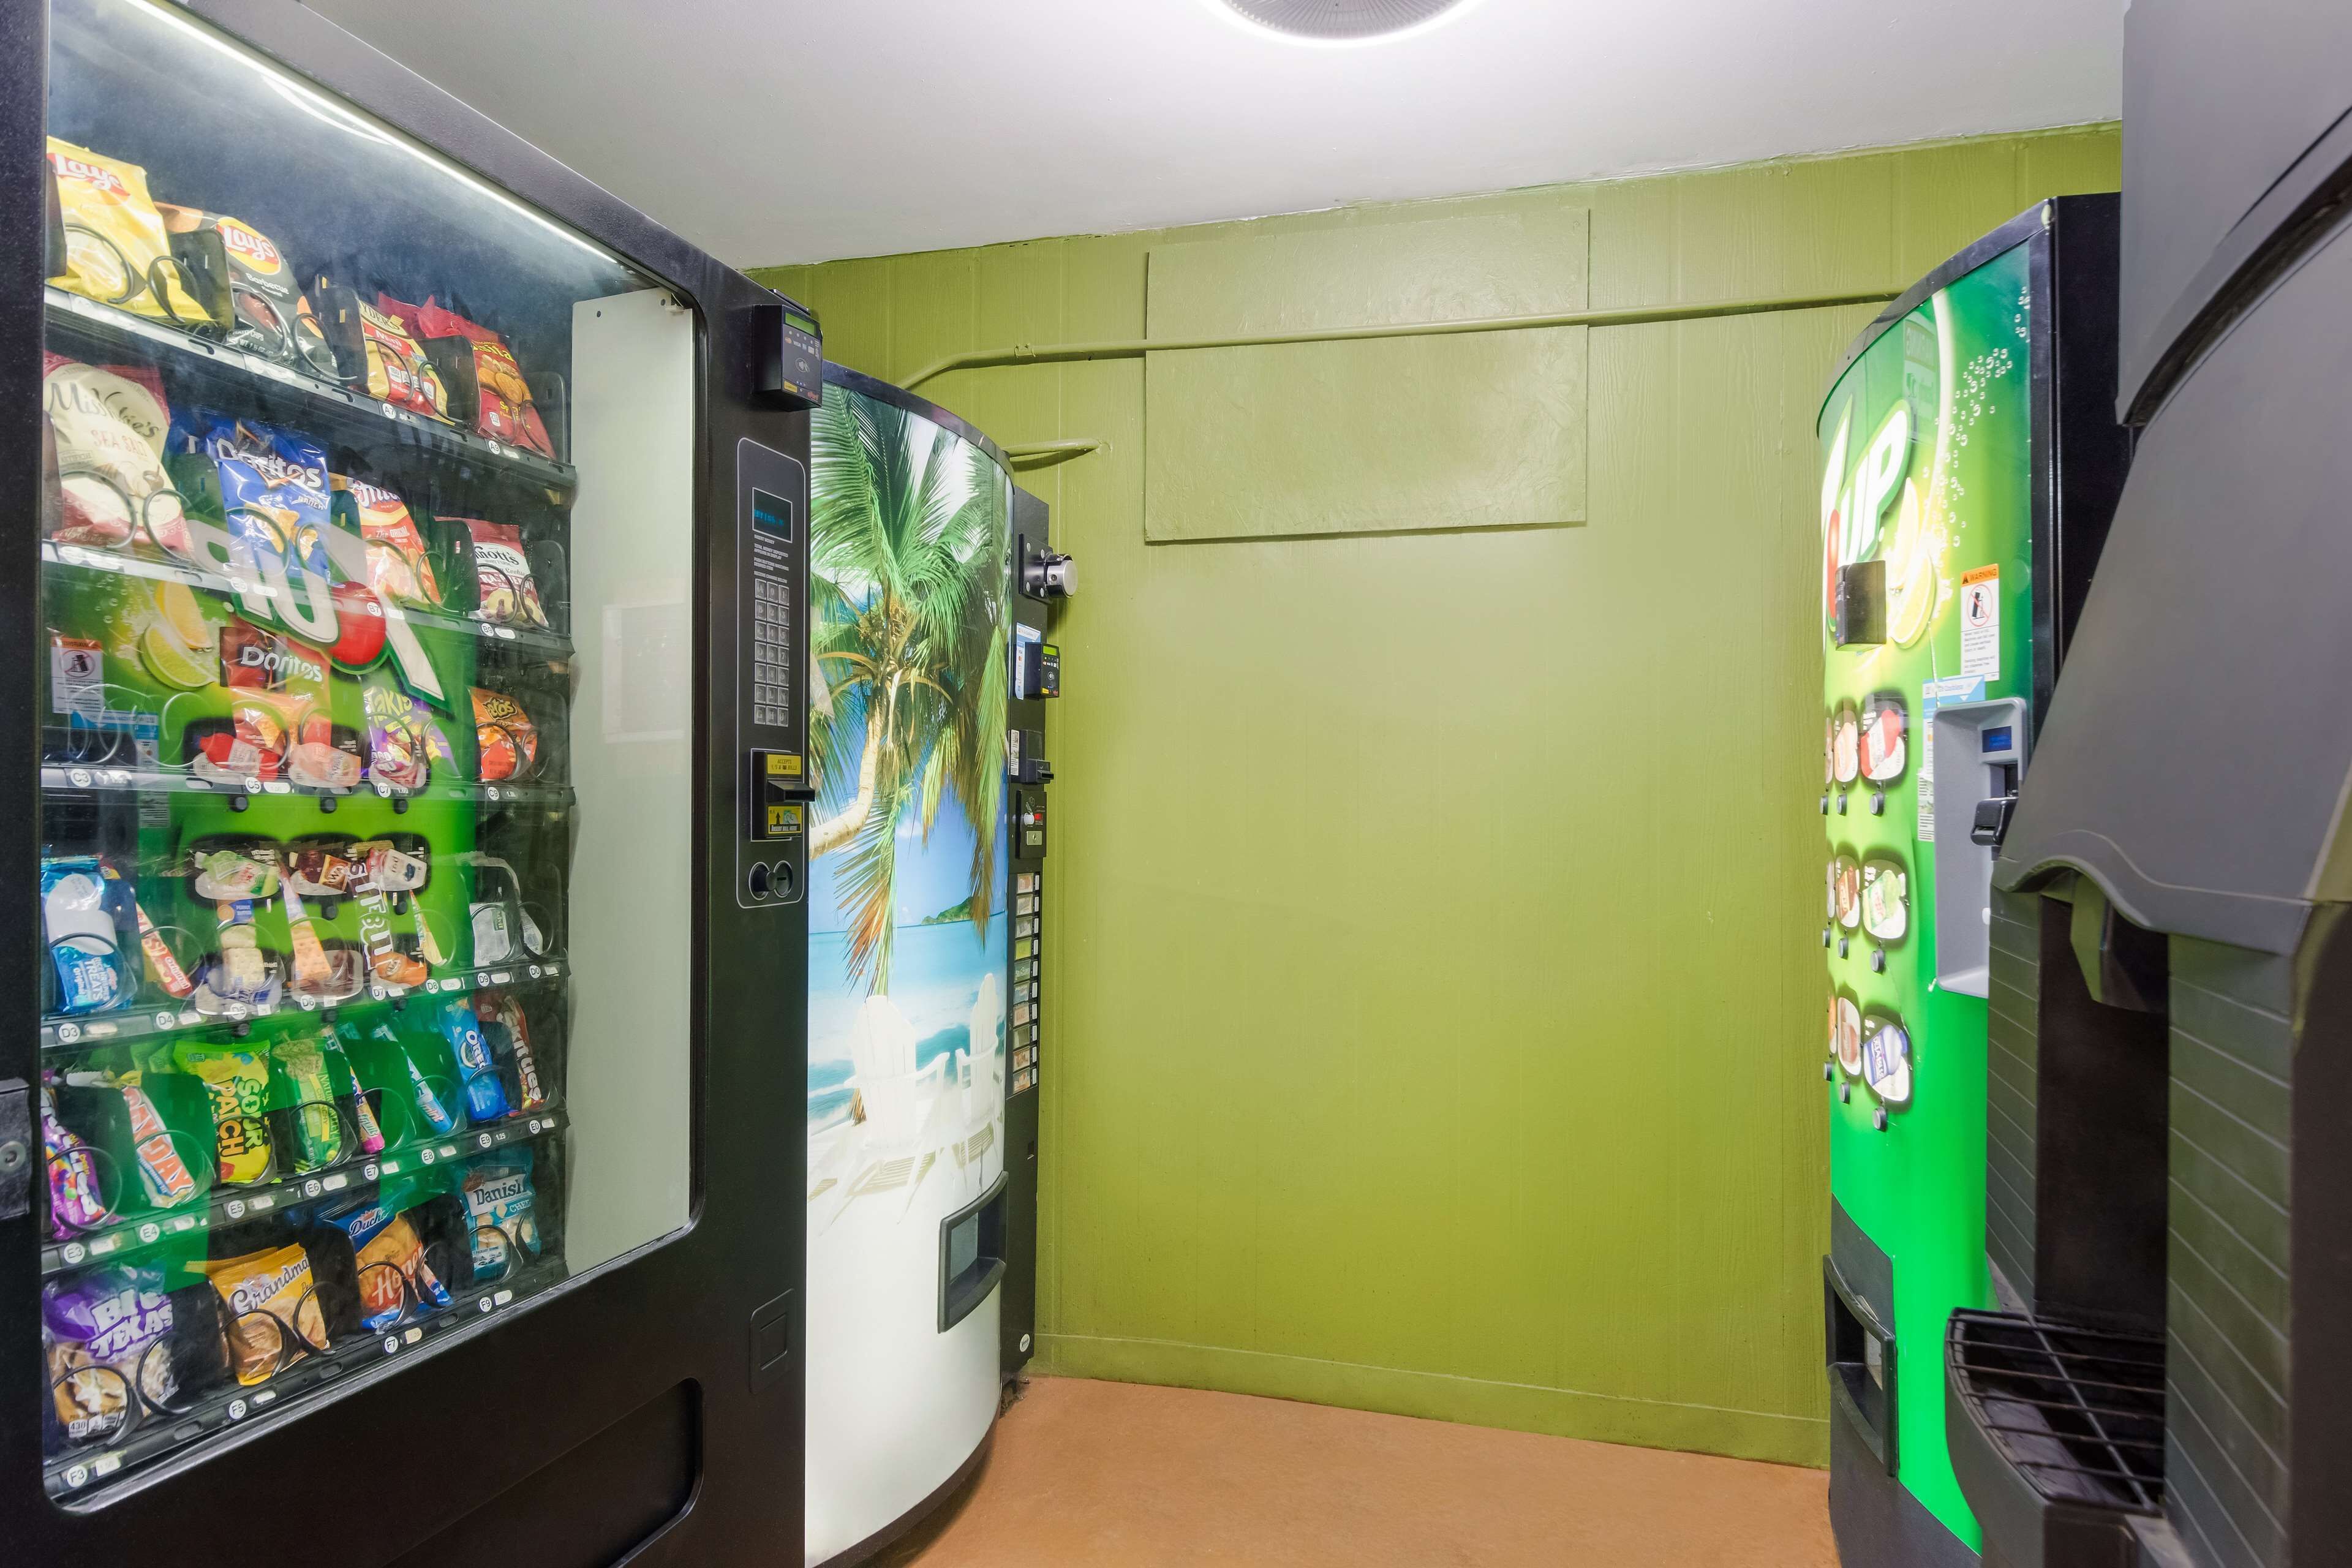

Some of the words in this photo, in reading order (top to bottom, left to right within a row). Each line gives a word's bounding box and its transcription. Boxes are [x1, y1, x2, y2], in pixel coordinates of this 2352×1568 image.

[246, 273, 290, 294] Barbecue
[384, 405, 395, 416] A7
[91, 429, 120, 450] SEA
[121, 434, 148, 458] SALT
[490, 443, 500, 452] A9
[216, 437, 323, 489] Dritos
[375, 529, 389, 538] The
[368, 605, 380, 614] B7
[482, 625, 493, 633] B9
[241, 646, 323, 684] Doritos
[73, 772, 89, 783] C3
[379, 785, 390, 794] C7
[489, 788, 499, 798] C9
[85, 959, 104, 1002] TREATS
[427, 982, 438, 990] D8
[373, 988, 384, 997] D7
[302, 998, 314, 1007] D6
[158, 1016, 173, 1026] D4
[61, 1027, 78, 1037] D3
[496, 1011, 543, 1102] Skittles
[236, 1078, 263, 1148] SOUR
[420, 1101, 445, 1123] mint
[212, 1079, 245, 1158] PATCH
[480, 1136, 491, 1144] E9
[422, 1152, 434, 1161] E8
[366, 1167, 377, 1177] E7
[307, 1183, 320, 1194] E6
[475, 1179, 527, 1206] Danish
[230, 1204, 243, 1215] E5
[141, 1227, 157, 1237] E4
[67, 1247, 83, 1259] E3
[481, 1299, 490, 1309] F9
[90, 1303, 174, 1358] TEXAS
[386, 1340, 396, 1350] F7
[232, 1404, 244, 1415] F5
[70, 1422, 86, 1432] 430
[70, 1470, 85, 1483] F3
